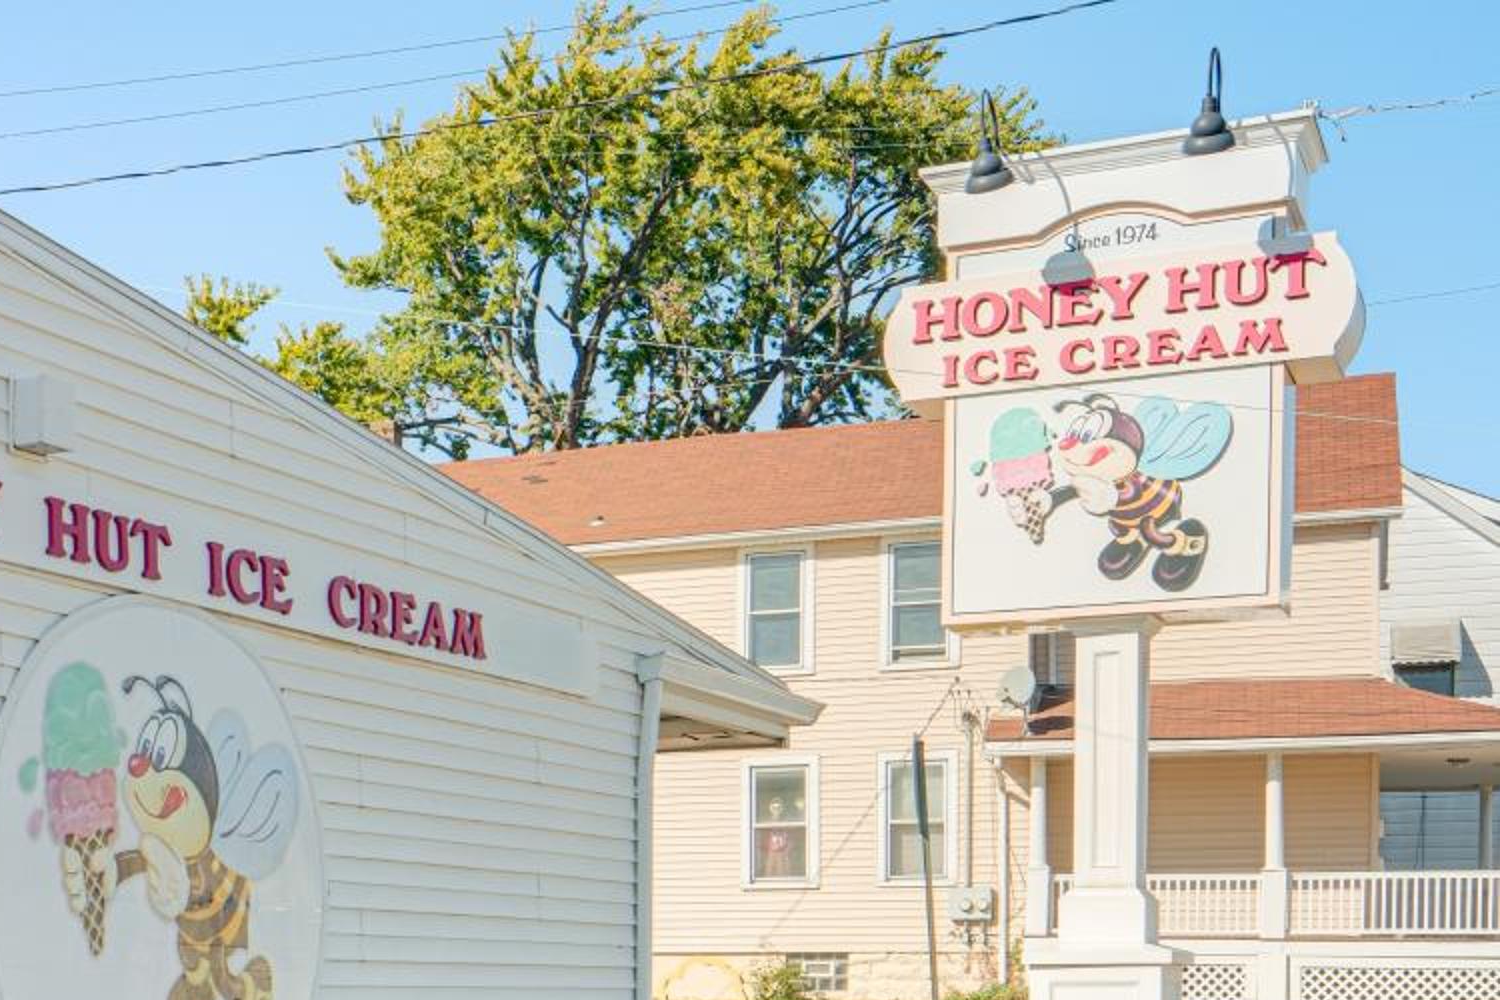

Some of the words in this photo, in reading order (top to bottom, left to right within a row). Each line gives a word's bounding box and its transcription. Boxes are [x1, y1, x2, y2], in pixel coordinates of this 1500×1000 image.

[1063, 231, 1111, 252] Since
[1115, 222, 1159, 246] 1974
[912, 270, 1149, 345] HONEY
[1164, 248, 1328, 314] HUT
[943, 344, 1040, 387] ICE
[1059, 317, 1288, 375] CREAM
[44, 495, 172, 582] HUT
[206, 541, 294, 616] ICE
[327, 574, 487, 661] CREAM
